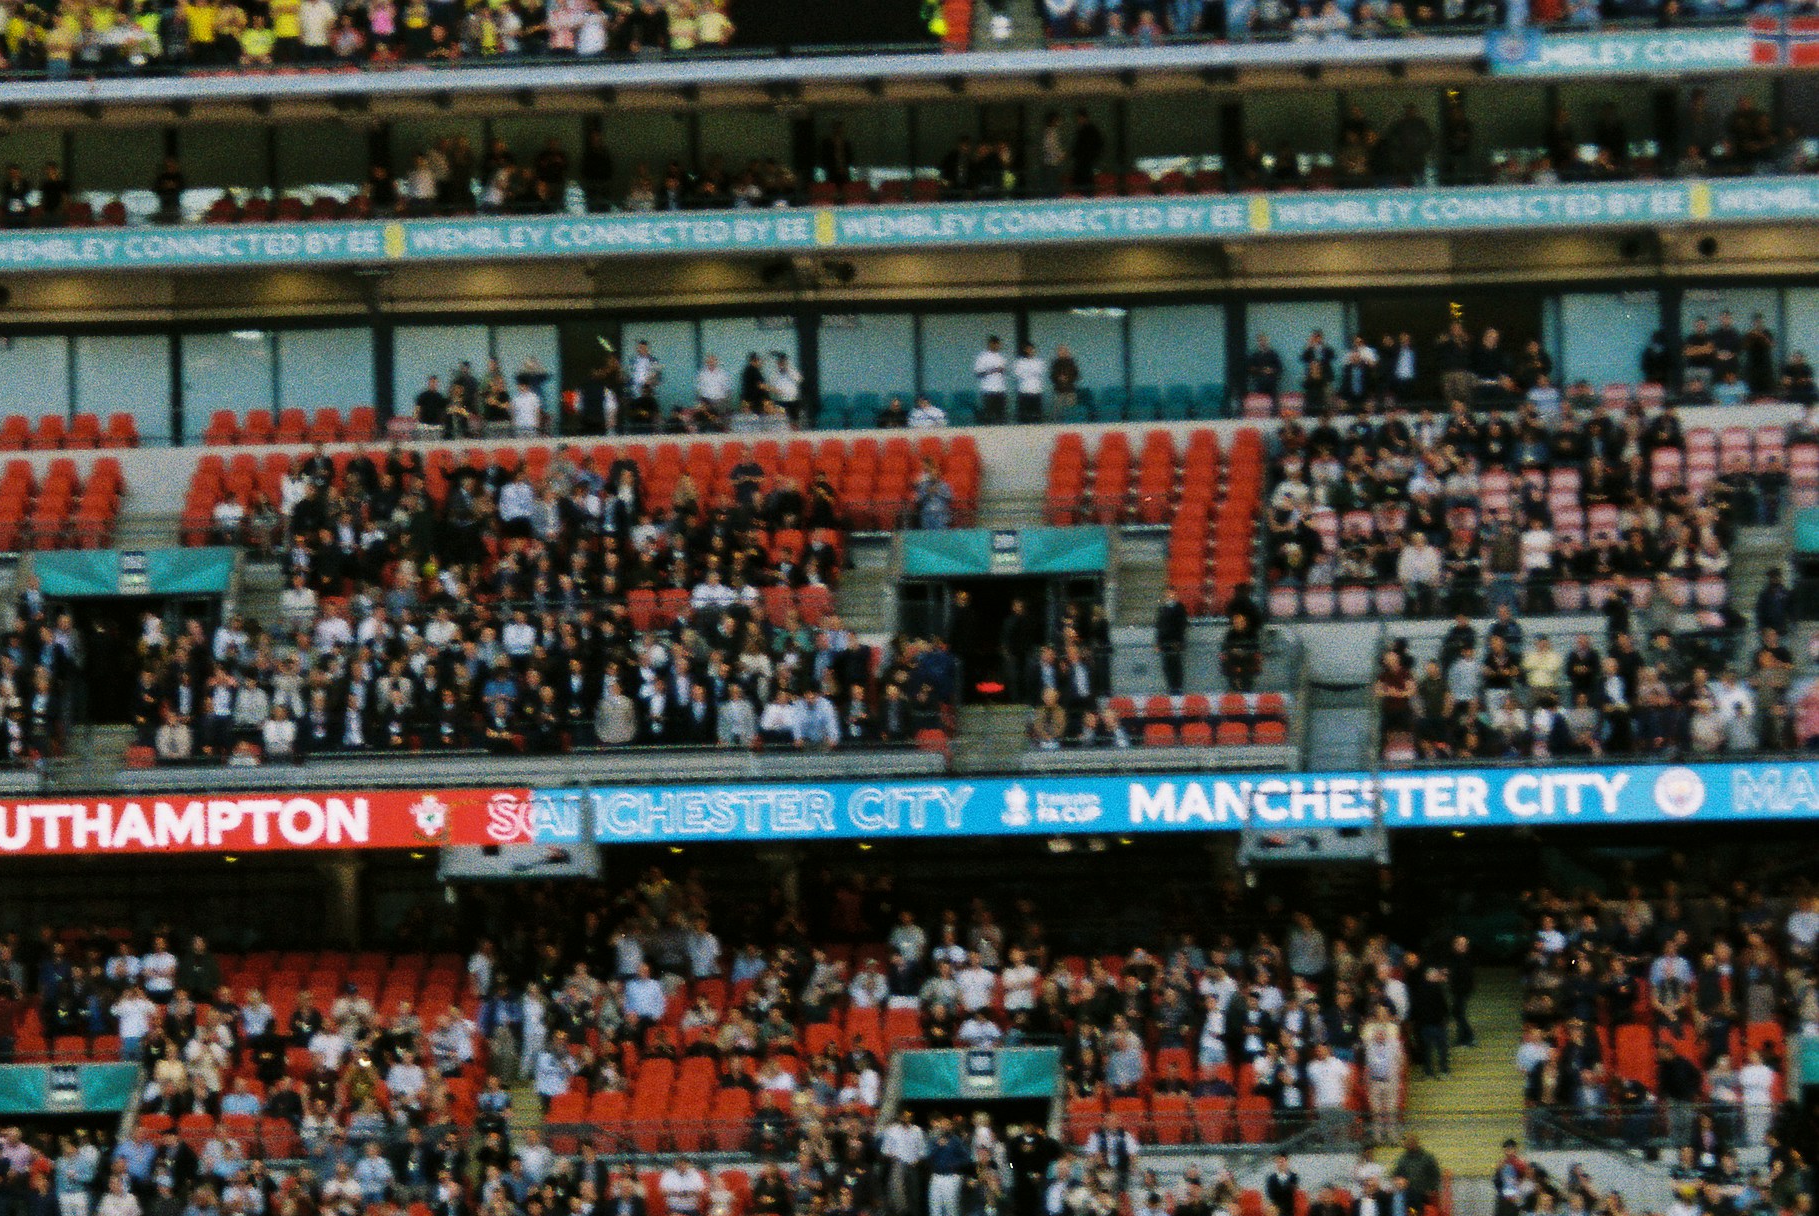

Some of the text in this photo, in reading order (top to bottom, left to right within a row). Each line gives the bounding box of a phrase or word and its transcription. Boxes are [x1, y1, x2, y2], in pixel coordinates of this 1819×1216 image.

[1528, 36, 1751, 69] MBLEY CONNE
[843, 203, 1243, 238] WEMBLEY CONNECTED BY EE
[1278, 190, 1683, 225] WEMBLEY CONNECTED BY EE
[125, 231, 299, 259] CONNECTED
[306, 230, 340, 254] BY
[347, 229, 379, 253] EE
[413, 216, 809, 251] WEMBLEY CONNECTED BY EE
[848, 784, 975, 831] CITY
[1503, 772, 1630, 817] CITY
